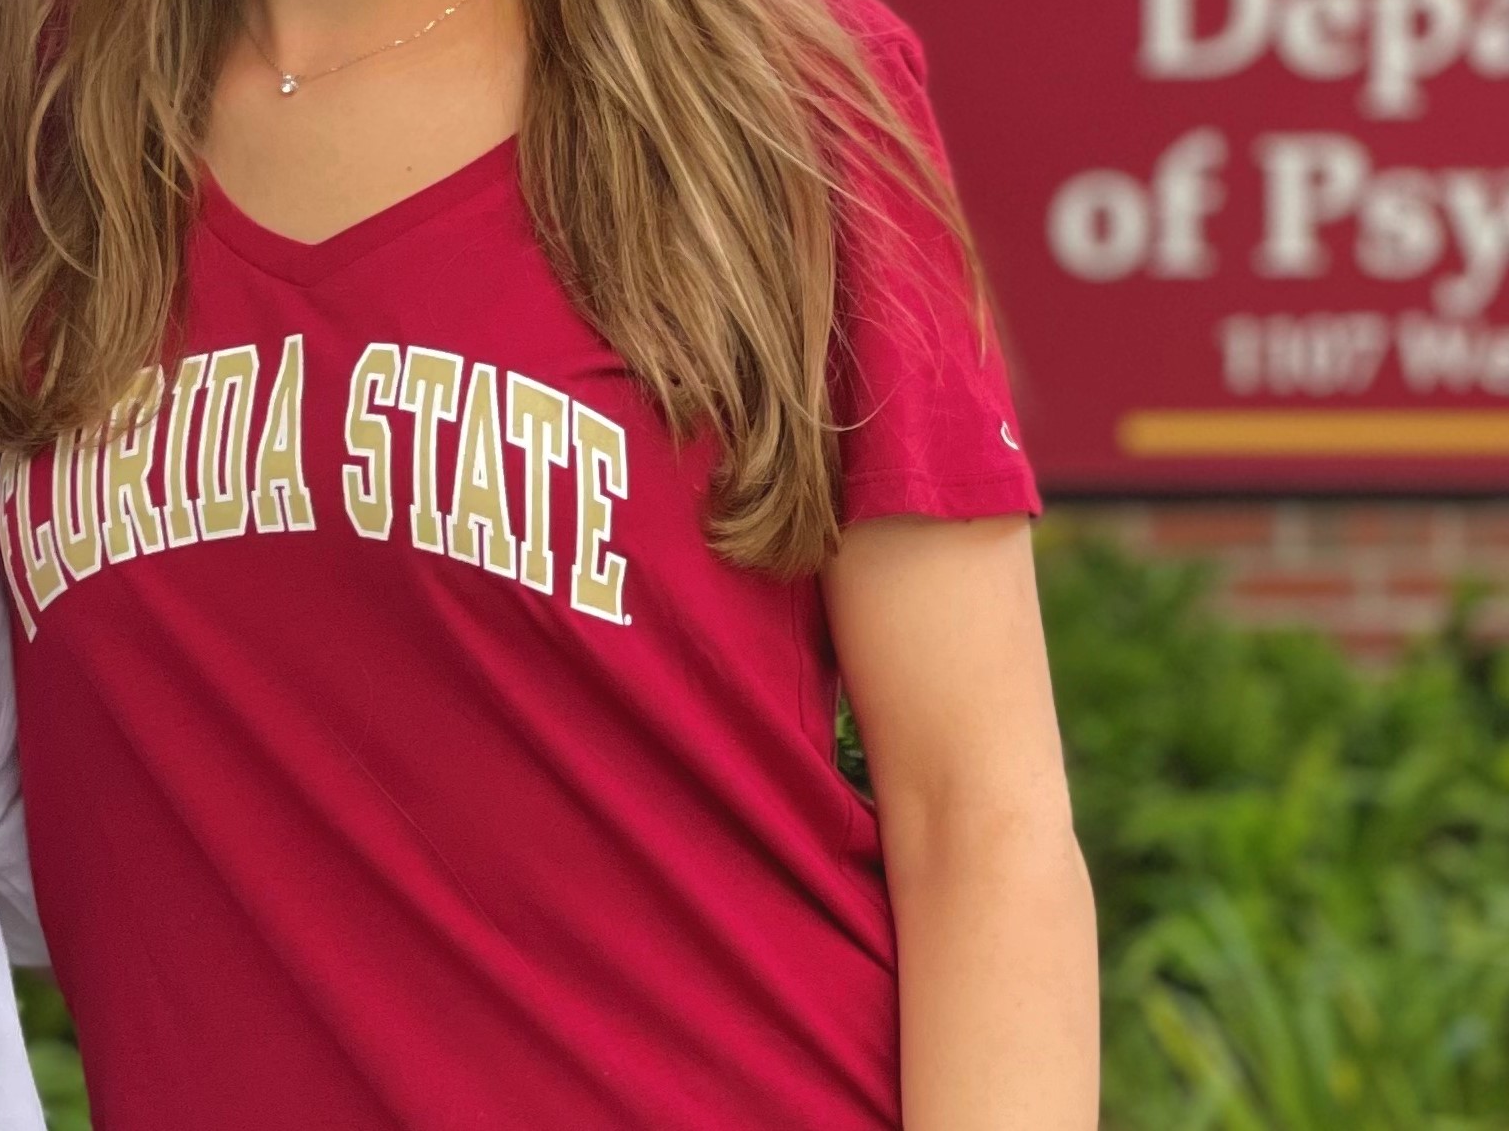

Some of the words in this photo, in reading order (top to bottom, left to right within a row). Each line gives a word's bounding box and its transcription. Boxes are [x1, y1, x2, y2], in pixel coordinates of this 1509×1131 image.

[1047, 127, 1228, 281] of
[1253, 132, 1509, 315] Psy
[342, 342, 628, 625] STATE
